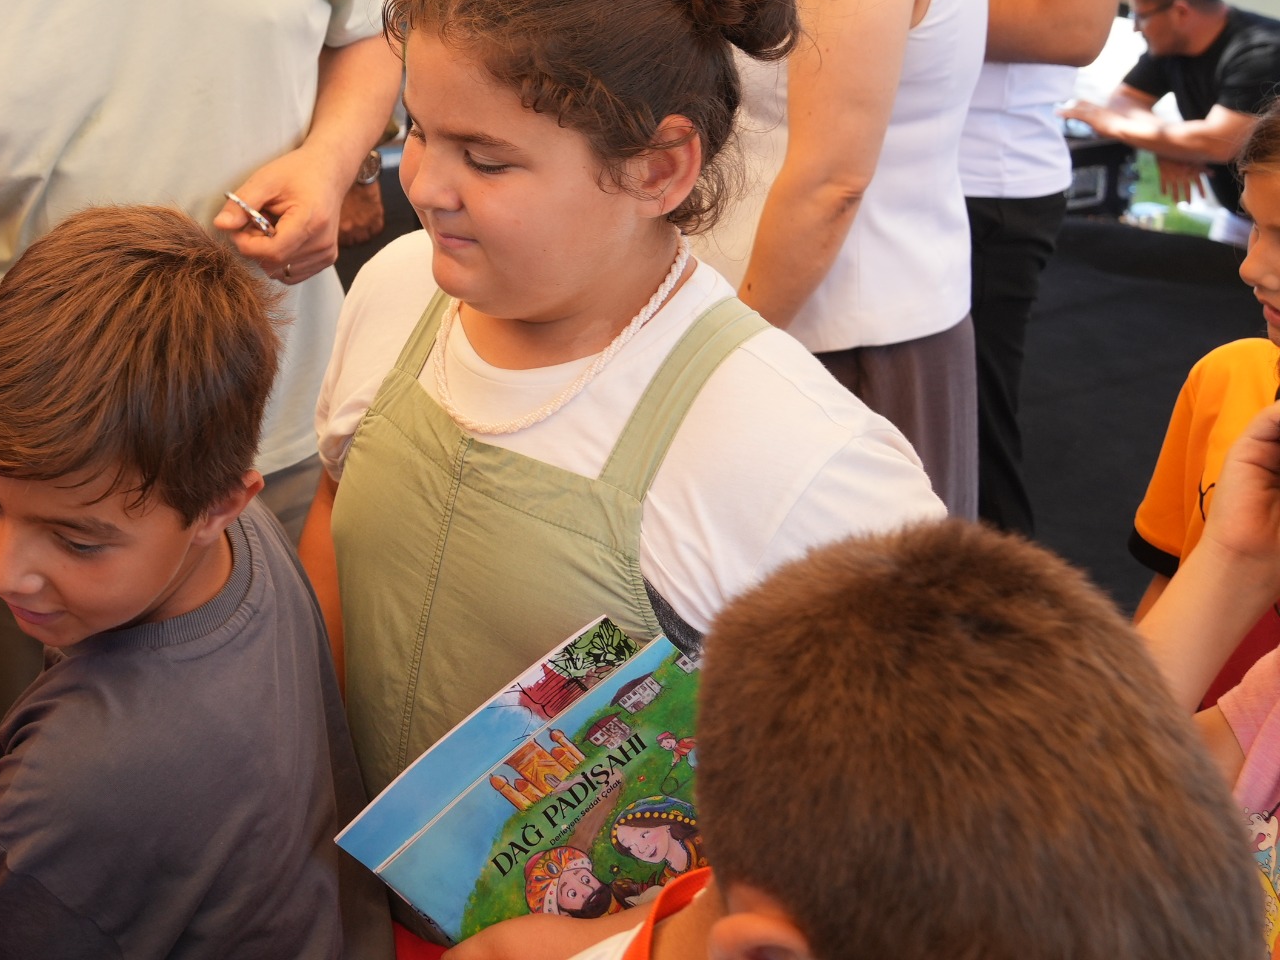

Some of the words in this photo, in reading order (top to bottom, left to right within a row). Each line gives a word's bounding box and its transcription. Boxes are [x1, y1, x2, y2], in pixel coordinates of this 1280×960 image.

[491, 823, 544, 877] DAĞ
[542, 733, 648, 828] PADİŞAHI
[549, 817, 581, 846] Derleyen:
[601, 779, 622, 798] Çolak
